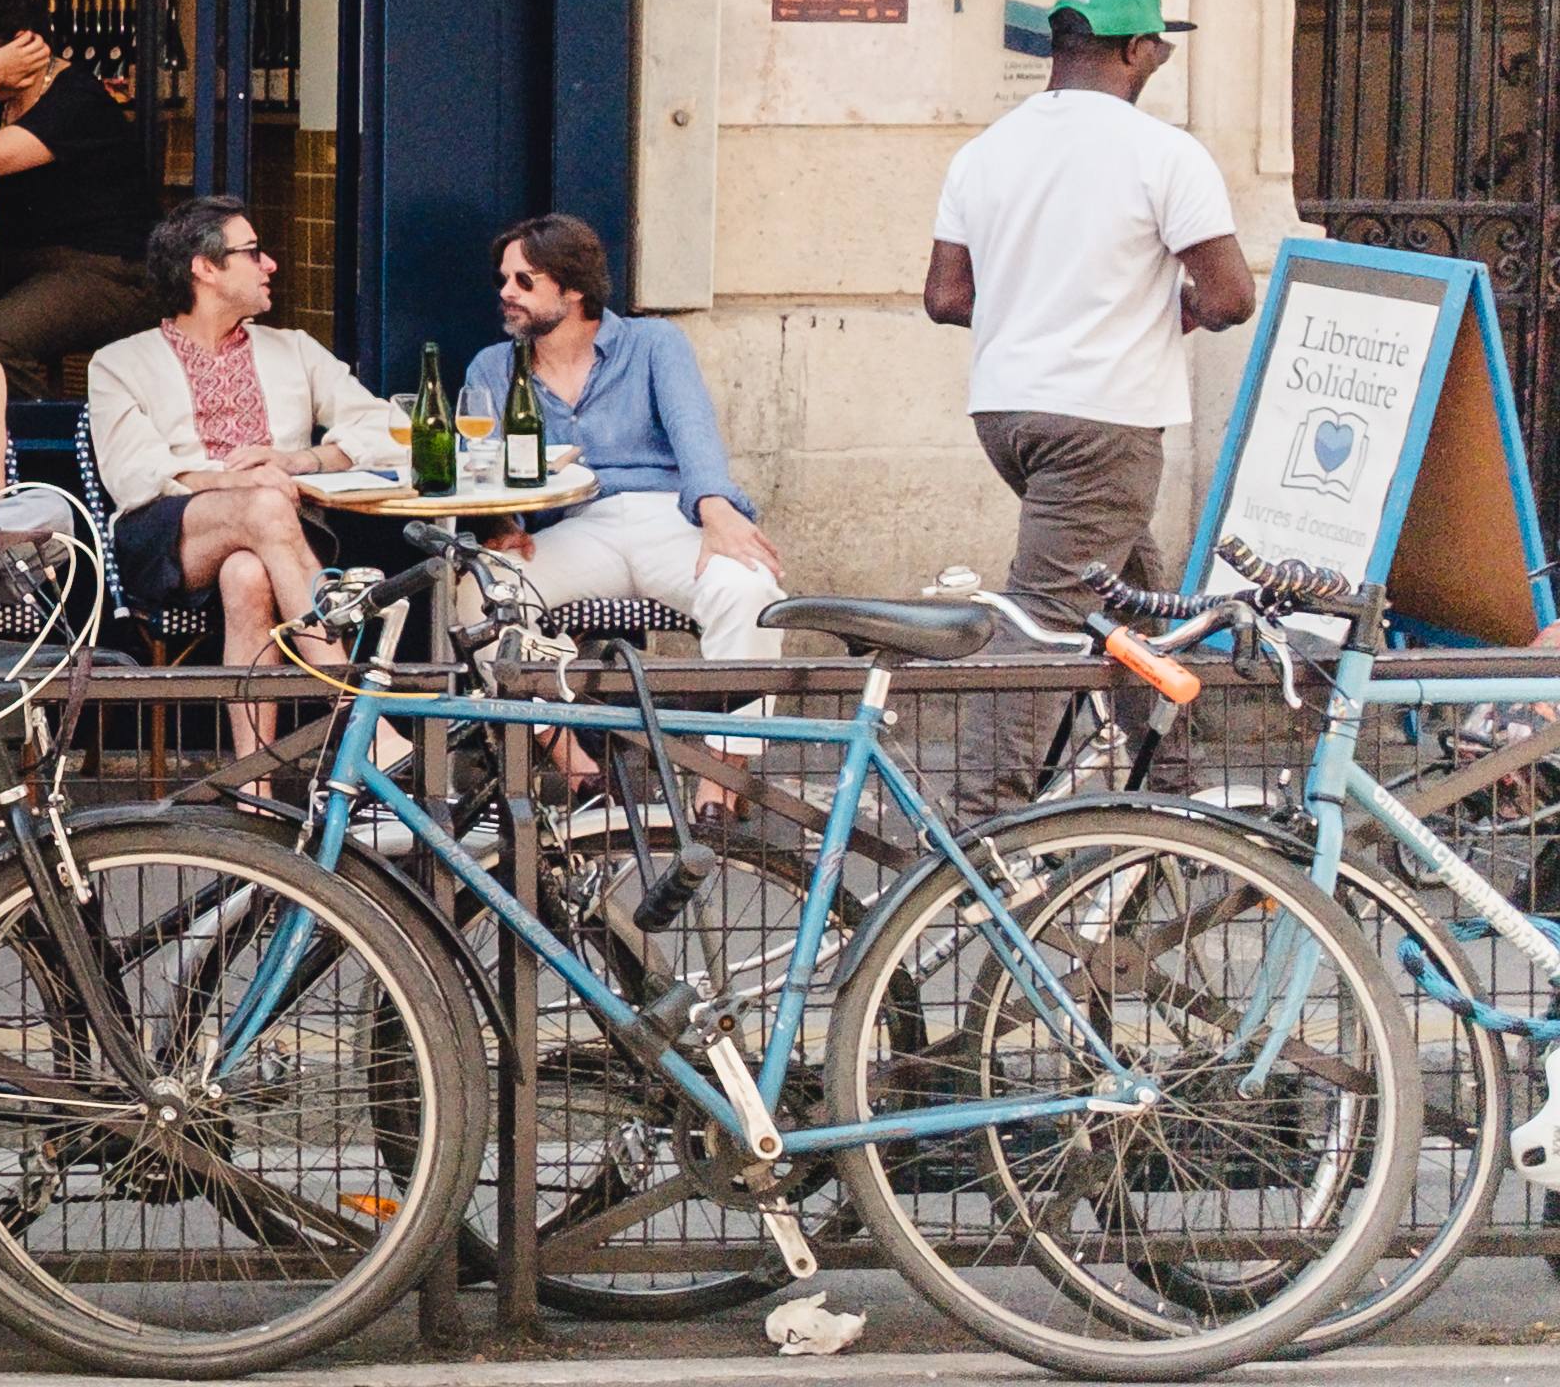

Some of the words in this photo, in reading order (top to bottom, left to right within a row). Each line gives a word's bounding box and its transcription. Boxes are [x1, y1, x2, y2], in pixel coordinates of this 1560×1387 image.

[1299, 315, 1410, 367] Librairie
[1286, 356, 1398, 410] Solidaire
[1243, 496, 1293, 528] livres
[1373, 786, 1437, 850] CINELLI
